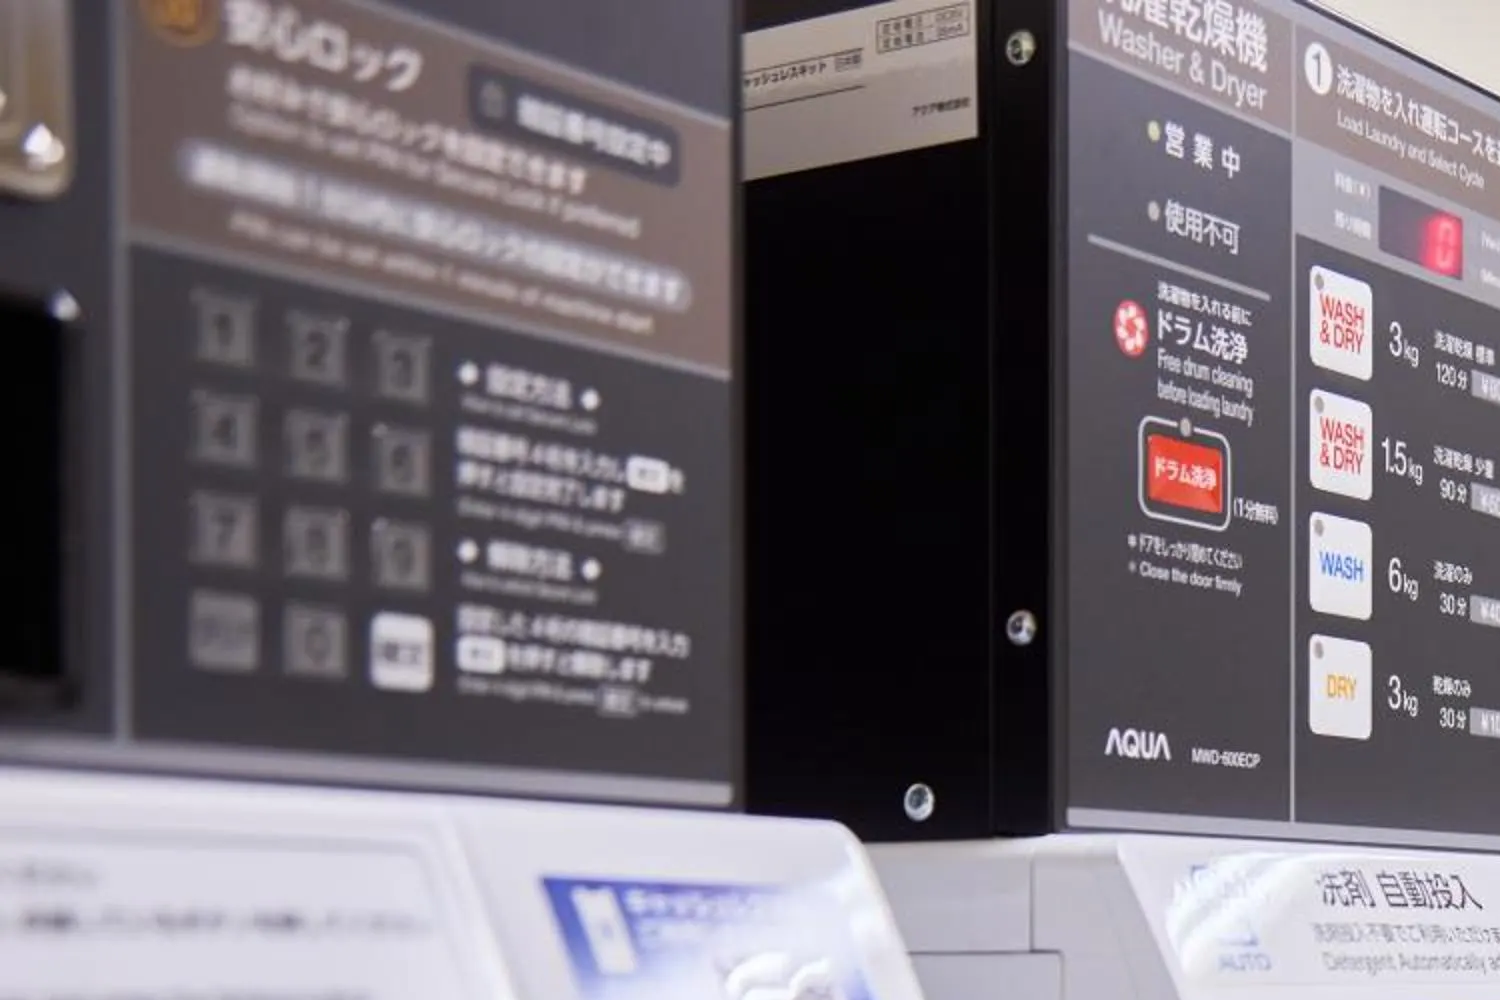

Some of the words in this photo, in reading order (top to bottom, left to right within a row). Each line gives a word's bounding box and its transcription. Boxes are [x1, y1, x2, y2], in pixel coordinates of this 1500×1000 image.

[1107, 0, 1268, 73] 乾燥機
[1098, 9, 1184, 74] Washer
[1188, 50, 1205, 85] &
[1211, 59, 1268, 110] Dryer
[1165, 121, 1241, 178] 営業中
[1337, 109, 1365, 137] Load
[1366, 124, 1406, 158] Laundry
[1428, 152, 1458, 177] Select
[1165, 199, 1240, 255] 使用不可
[1319, 293, 1365, 329] WASH
[1158, 308, 1249, 364] ドラム洗浄
[1319, 320, 1330, 345] &
[1333, 324, 1364, 354] DRY
[1157, 376, 1187, 405] before
[1158, 347, 1181, 374] Free
[1183, 356, 1210, 381] drum
[1211, 366, 1253, 399] cleaning
[1319, 415, 1364, 450] WASH
[1154, 455, 1217, 491] ドラム洗浄
[1319, 443, 1330, 468] &
[1333, 446, 1364, 475] DRY
[1139, 561, 1170, 581] Close
[1171, 567, 1188, 584] the
[1189, 571, 1213, 588] door
[1215, 575, 1243, 597] firmly
[1319, 551, 1364, 583] WASH
[1326, 672, 1357, 700] DRY
[1104, 727, 1172, 761] AQUA
[1315, 868, 1377, 908] 洗剤
[1376, 872, 1484, 911] 自動投入
